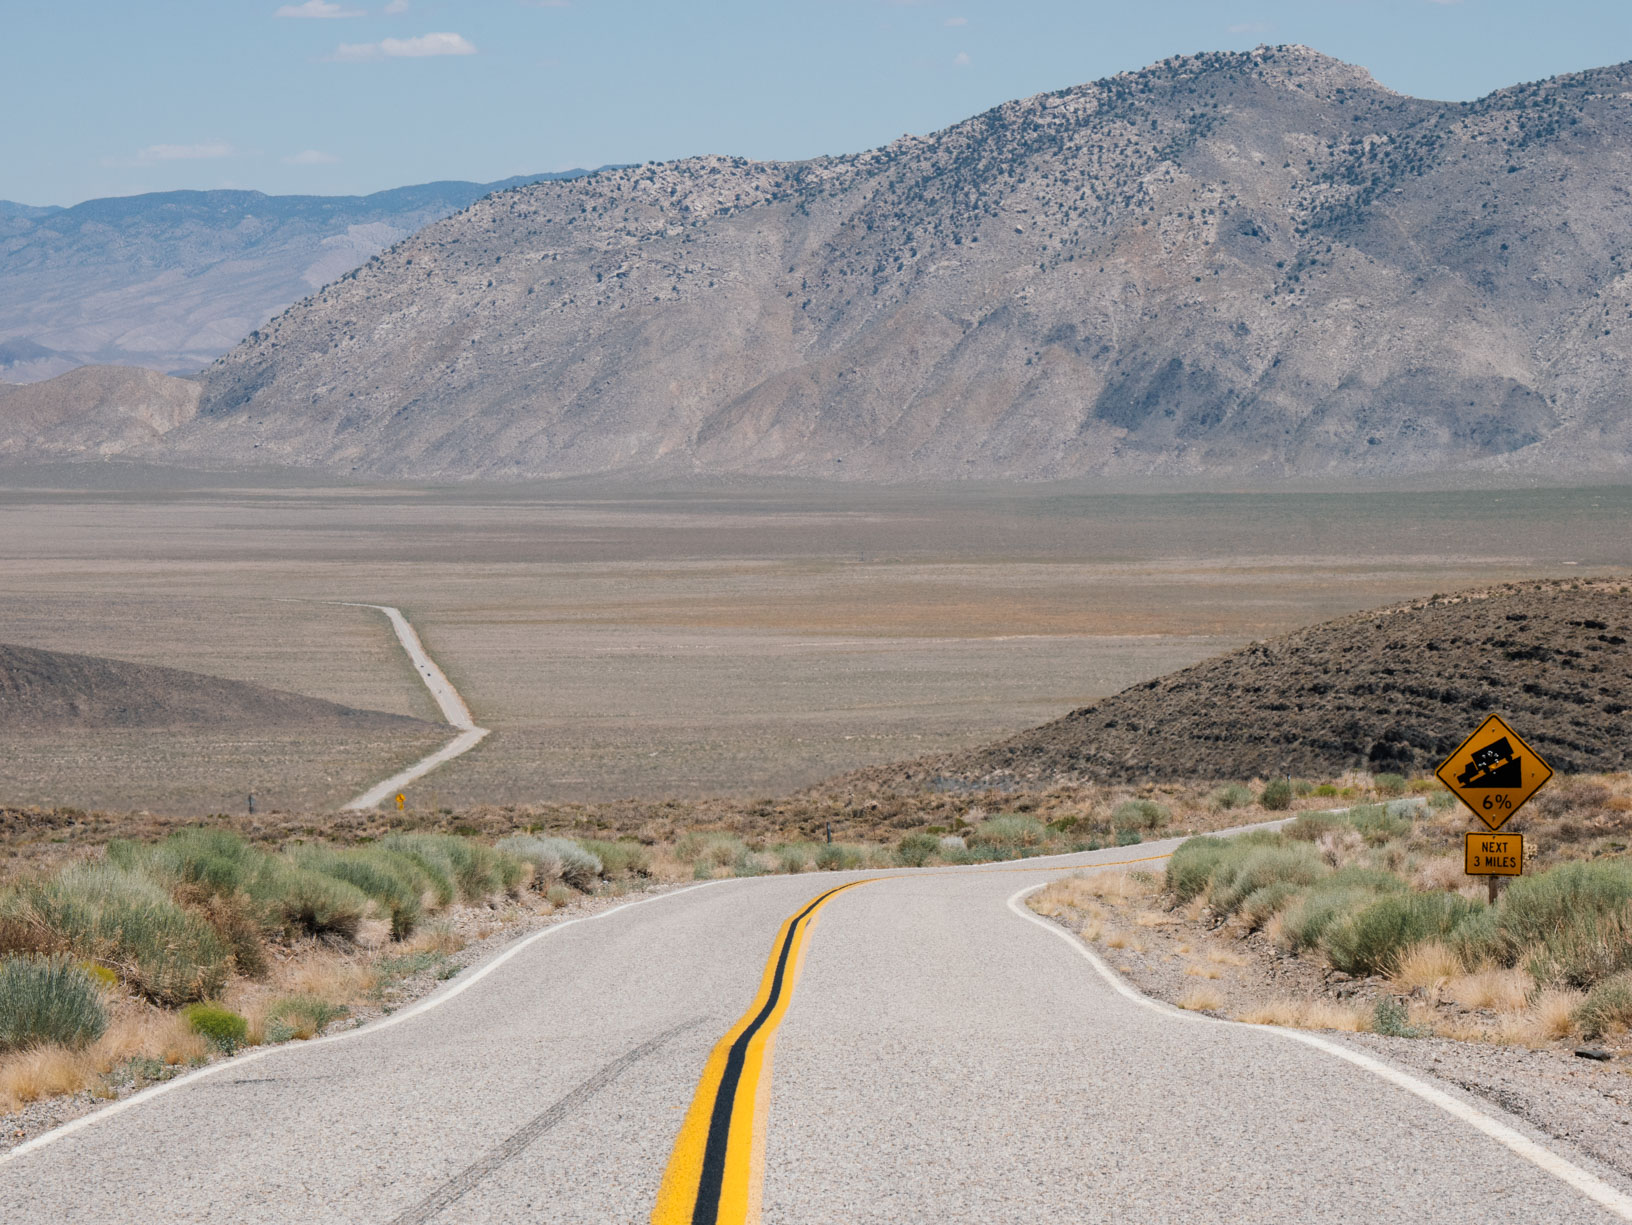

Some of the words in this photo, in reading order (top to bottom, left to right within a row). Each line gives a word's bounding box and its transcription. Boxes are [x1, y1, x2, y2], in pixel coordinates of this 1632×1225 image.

[1482, 794, 1512, 810] 6%
[1482, 842, 1508, 853] NEXT
[1474, 856, 1480, 867] 3
[1485, 856, 1516, 868] MILES
